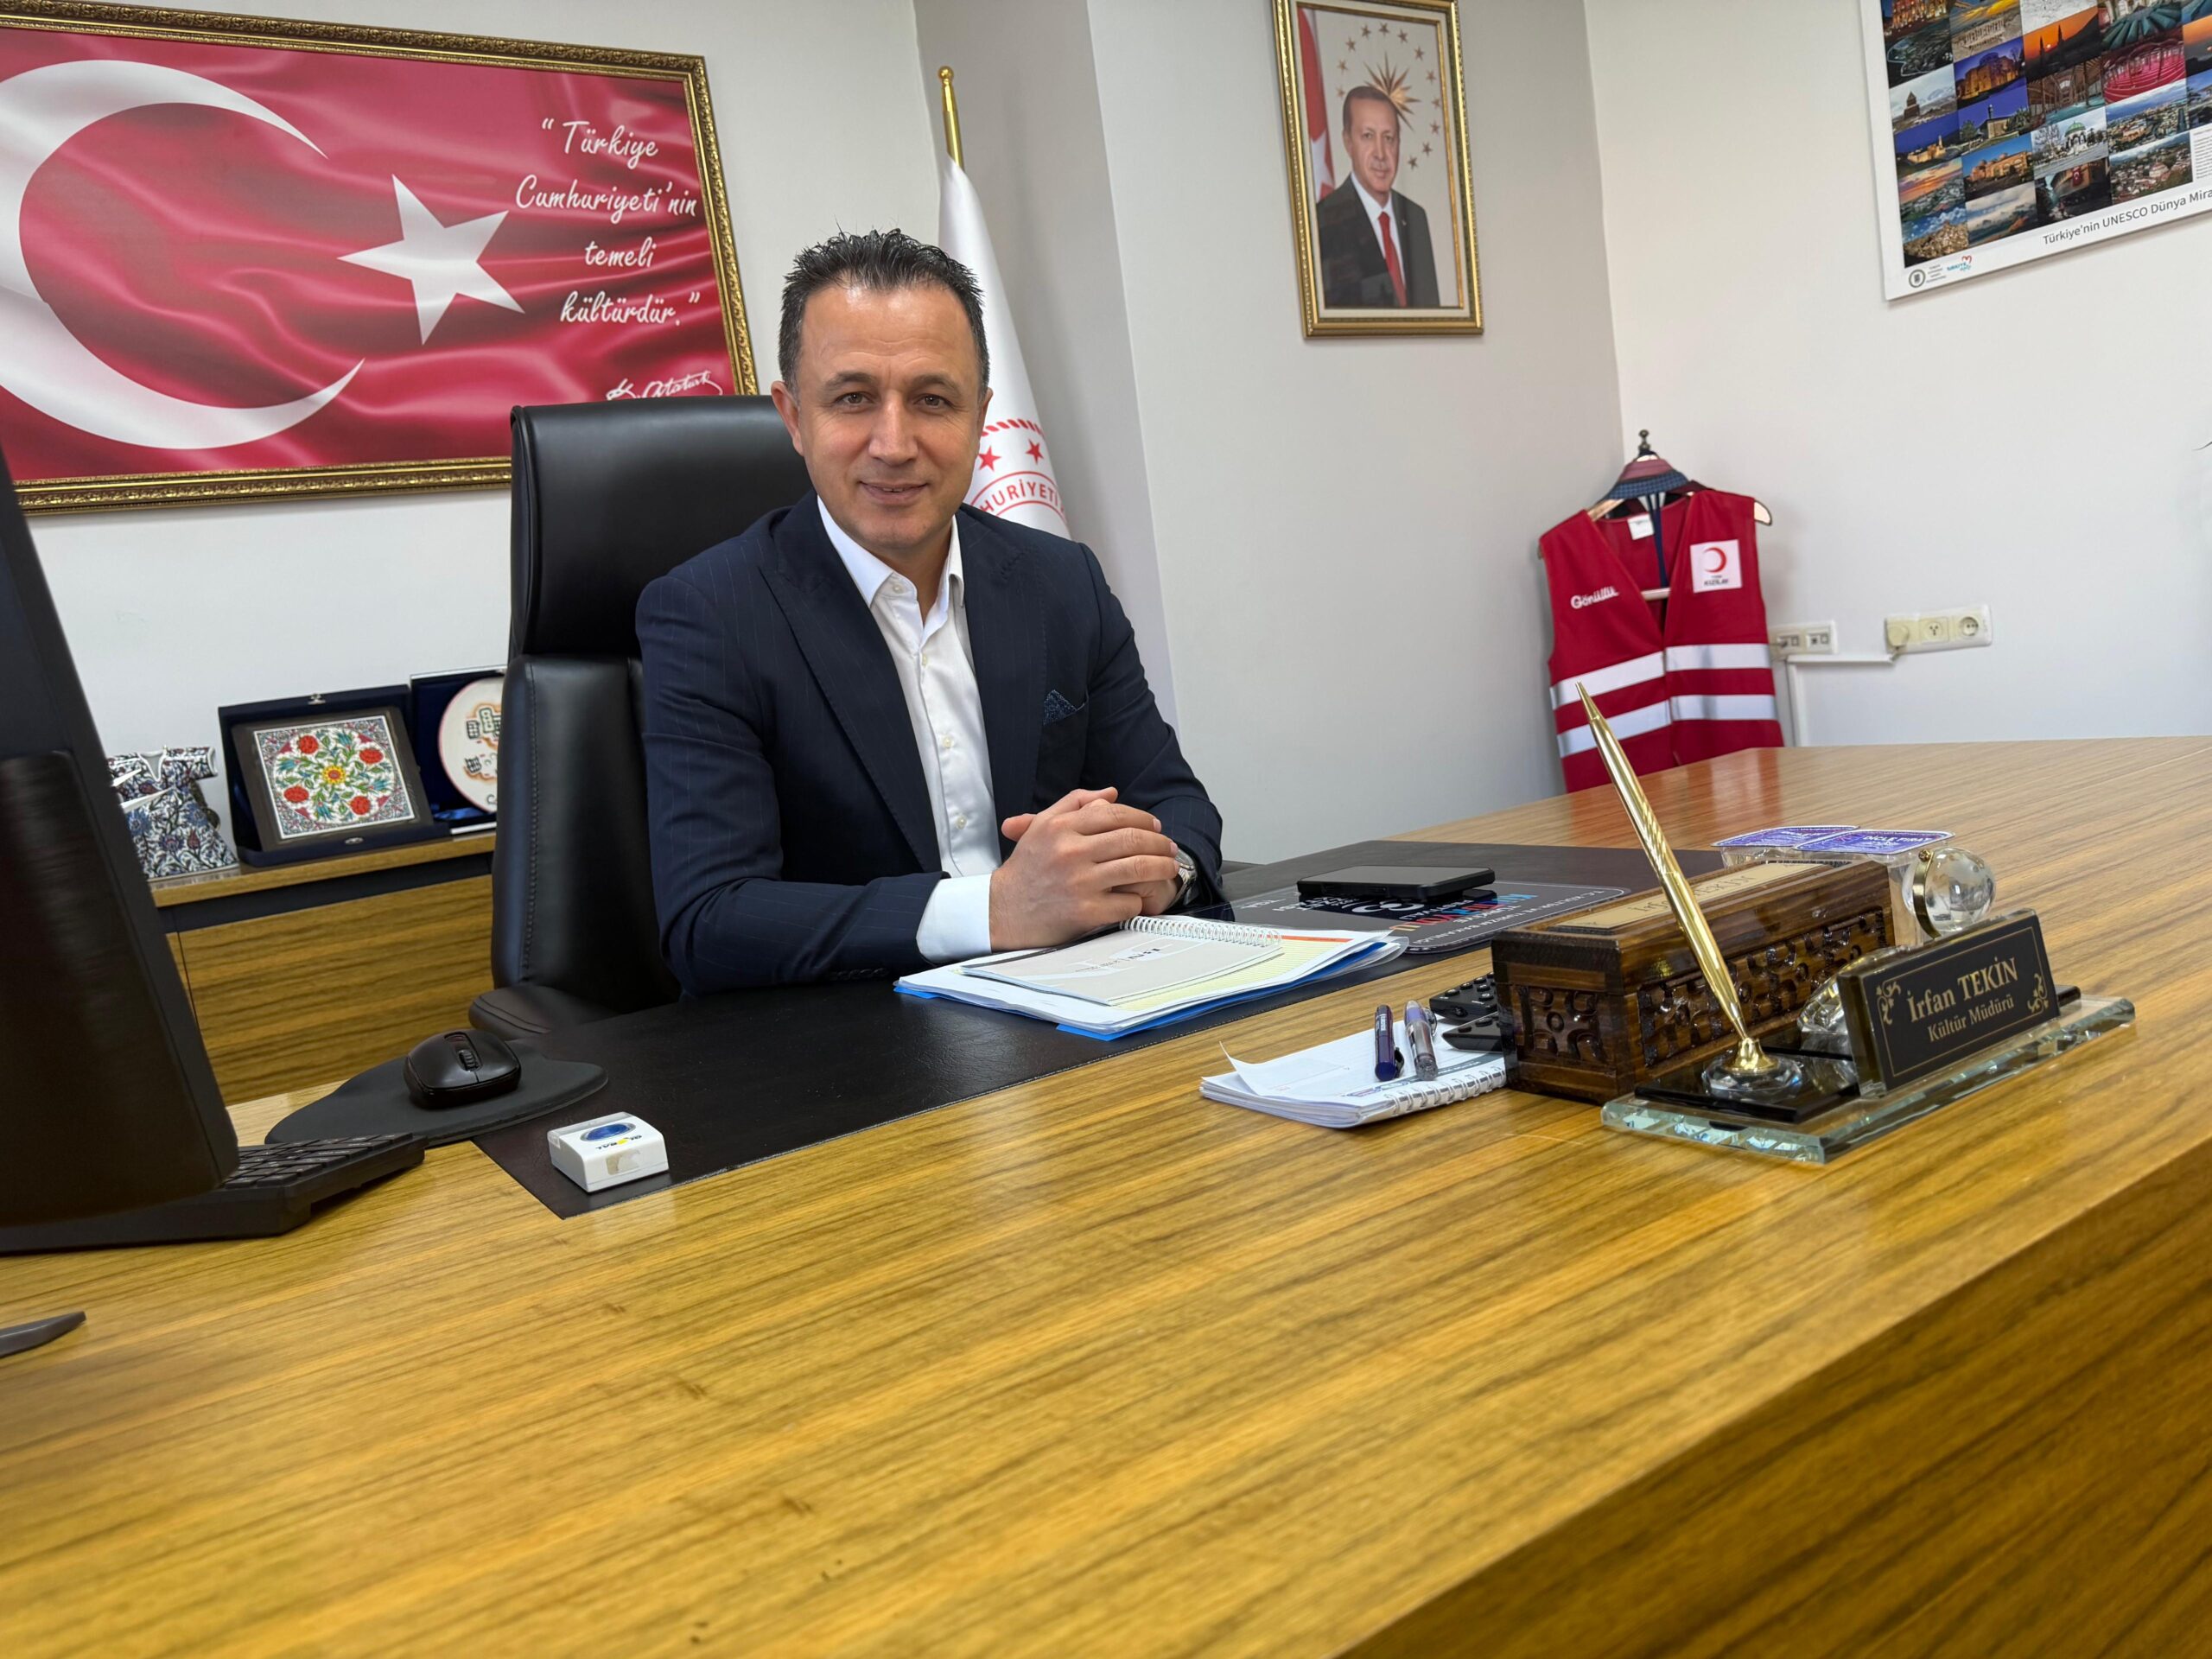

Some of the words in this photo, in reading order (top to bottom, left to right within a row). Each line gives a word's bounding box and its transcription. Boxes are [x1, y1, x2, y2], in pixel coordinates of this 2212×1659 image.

[516, 175, 696, 224] Cumhuriyeti'nin
[2043, 221, 2101, 245] Türkiye'nin
[2102, 207, 2149, 228] UNESCO
[2152, 197, 2187, 214] Dünya
[584, 236, 658, 268] temeli
[1906, 988, 1957, 1024] İrfan
[1957, 955, 2020, 1001] TEKİN
[1927, 1014, 1968, 1043] Kültür
[1969, 993, 2015, 1027] Müdürü
